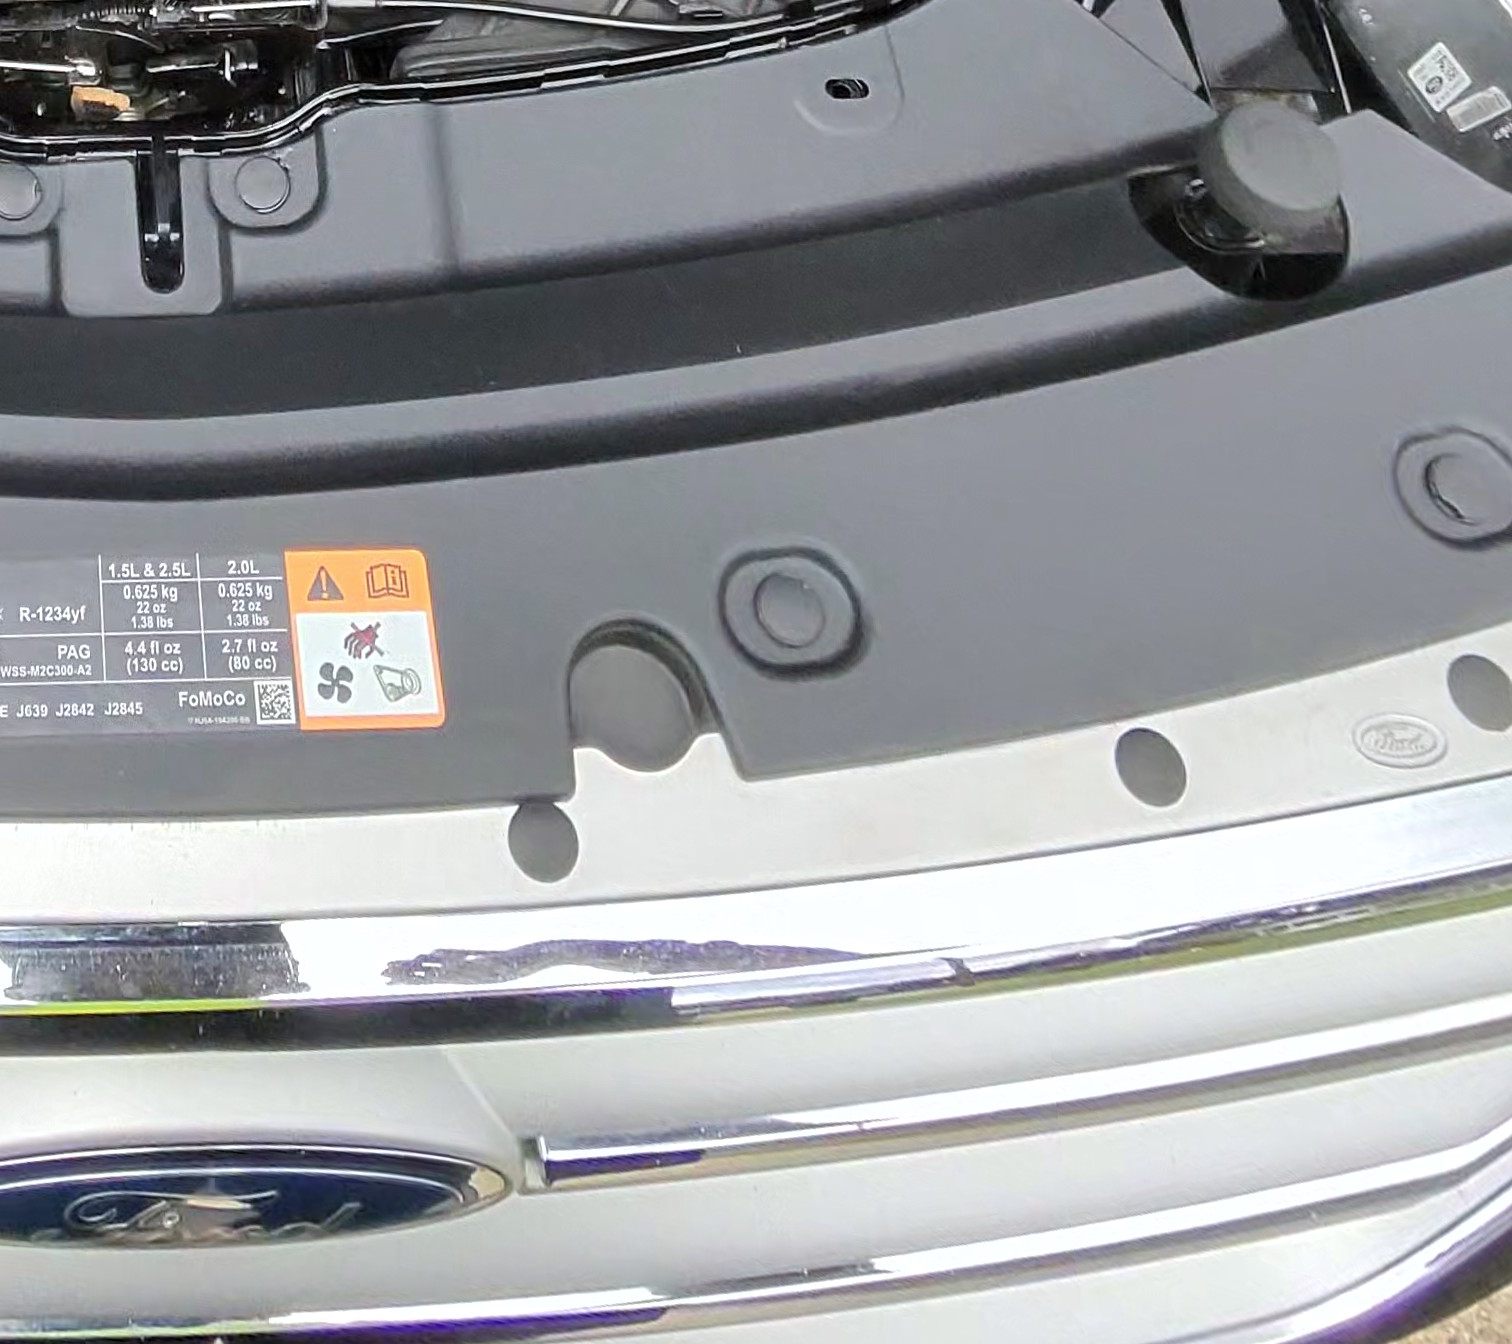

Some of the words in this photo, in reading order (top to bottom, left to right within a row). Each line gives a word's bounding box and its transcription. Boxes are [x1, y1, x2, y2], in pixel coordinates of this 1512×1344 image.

[108, 563, 140, 578] 1.5L
[143, 563, 155, 577] &
[159, 562, 191, 577] 2.5L
[227, 560, 259, 575] 2.0L
[123, 584, 158, 600] 0.625
[161, 584, 178, 602] kg
[217, 583, 253, 598] 0.625
[256, 582, 273, 600] kg
[137, 602, 150, 614] 22
[153, 603, 167, 613] oz
[231, 600, 245, 612] 22
[248, 601, 262, 612] oz
[19, 605, 87, 625] R-1234yf
[131, 616, 154, 629] 1.38
[156, 616, 174, 628] lbs
[226, 614, 249, 627] 1.38
[252, 613, 270, 626] lbs
[57, 644, 91, 660] PAG
[124, 641, 147, 655] 4.4
[150, 640, 160, 655] fl
[163, 642, 181, 655] oz
[221, 638, 243, 654] 2.7
[247, 638, 257, 653] fl
[260, 641, 279, 653] oz
[0, 664, 92, 678] WSS-M2C300-A2
[126, 658, 157, 676] (130
[161, 657, 184, 675] cc)
[228, 656, 251, 674] (80
[254, 655, 277, 672] cc)
[178, 690, 246, 708] FoMoCo
[16, 704, 48, 718] J639
[55, 703, 95, 717] J2842
[104, 702, 143, 716] J2845
